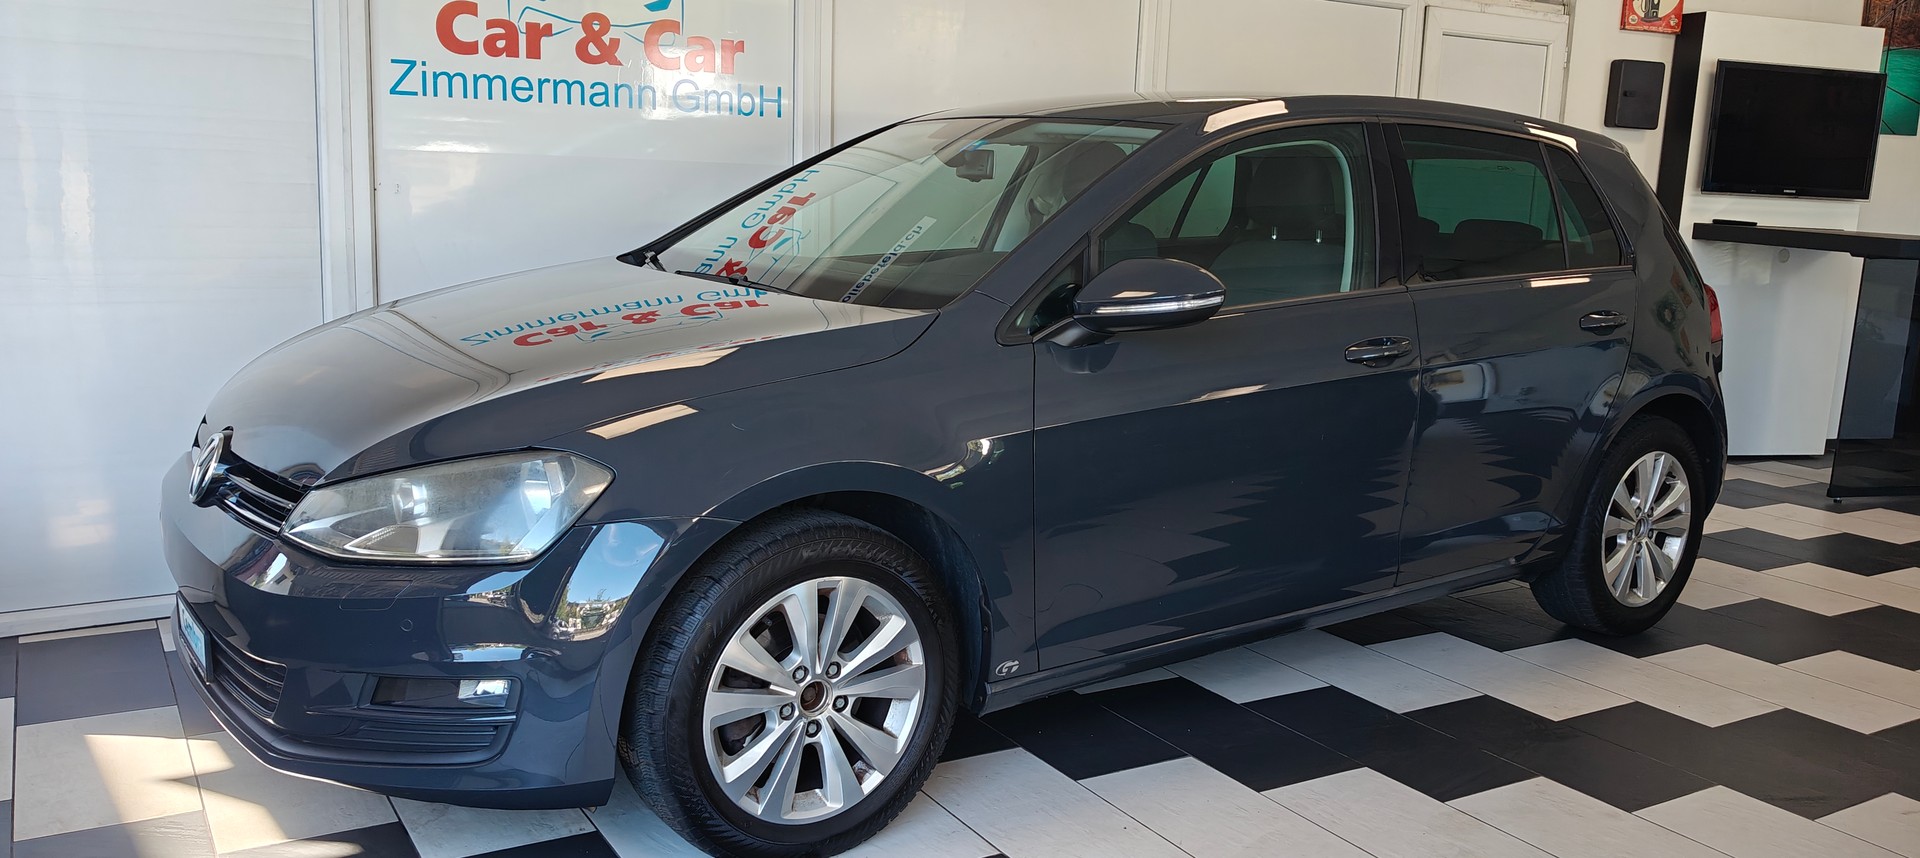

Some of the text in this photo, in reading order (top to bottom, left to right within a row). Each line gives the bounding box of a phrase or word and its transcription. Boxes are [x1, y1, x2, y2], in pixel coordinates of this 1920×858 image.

[436, 0, 746, 75] Car & Car
[388, 57, 783, 119] Zimmermann GmbH
